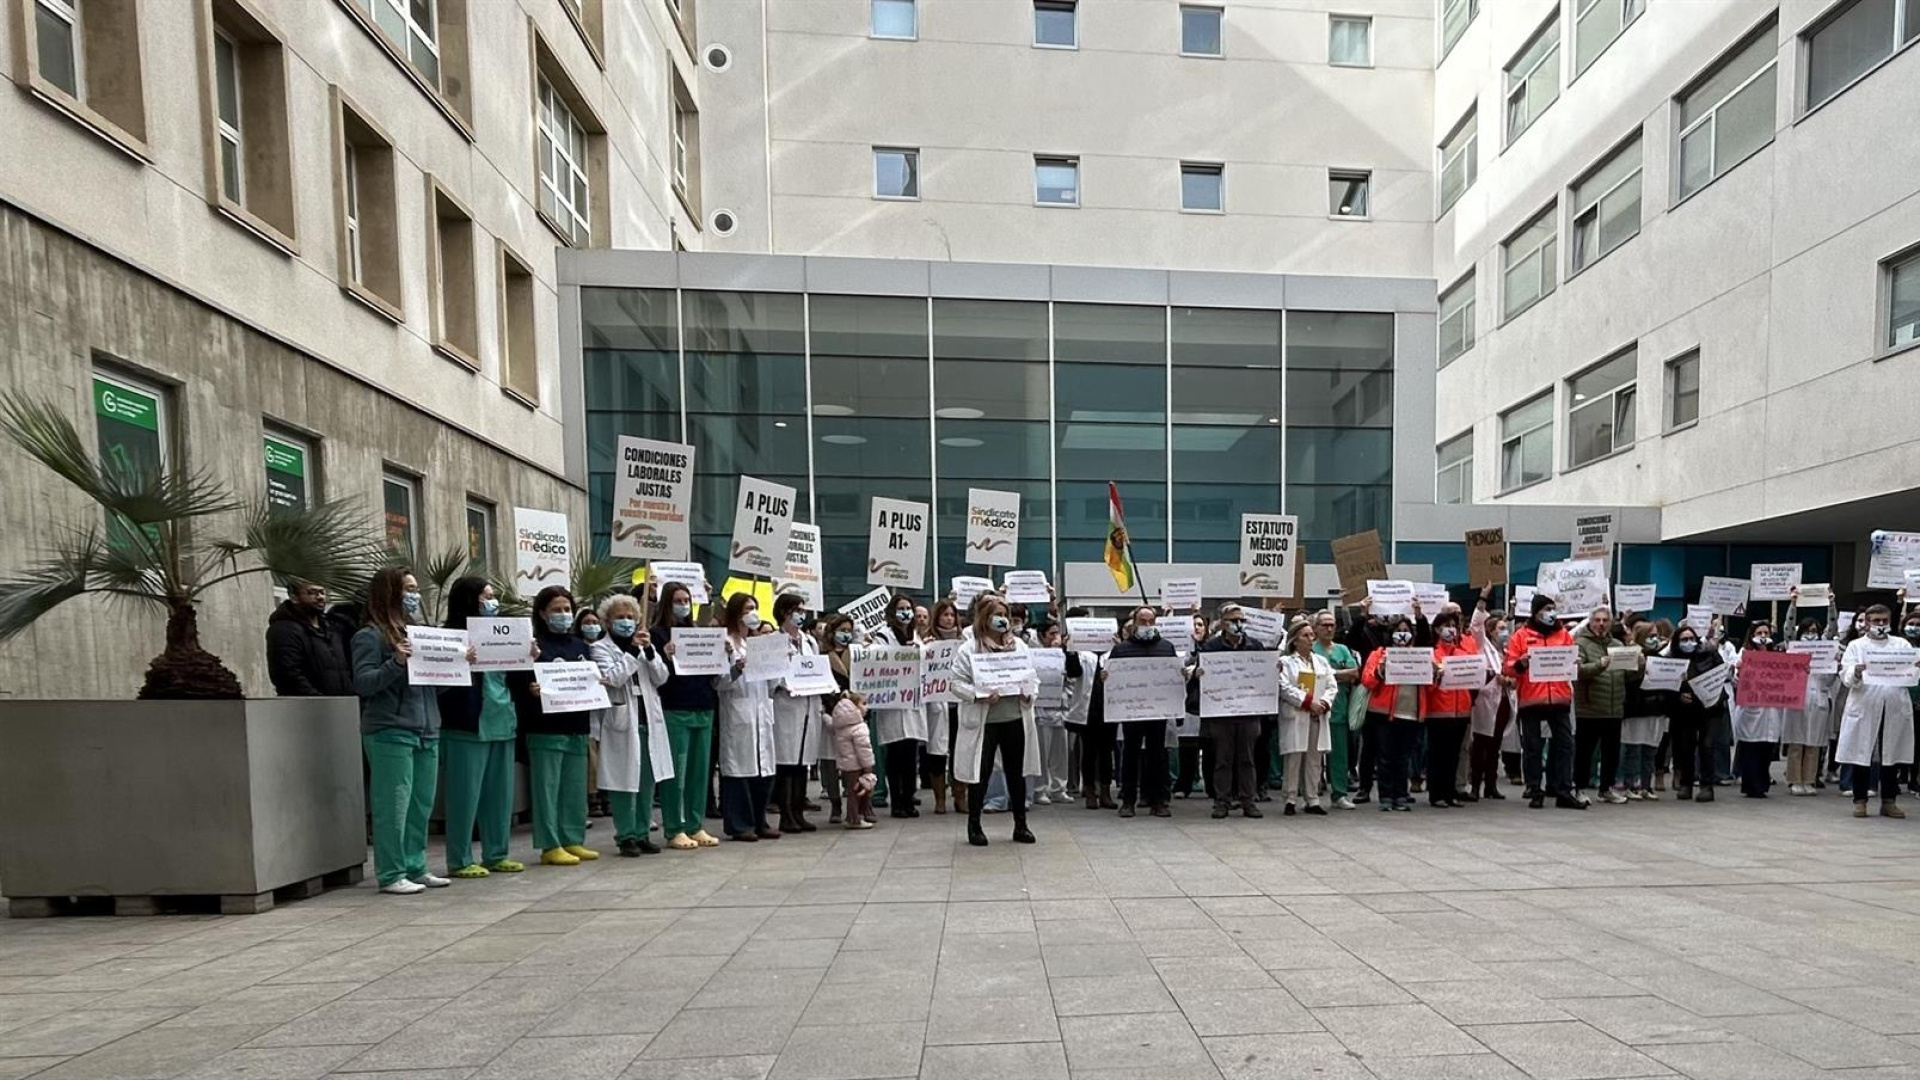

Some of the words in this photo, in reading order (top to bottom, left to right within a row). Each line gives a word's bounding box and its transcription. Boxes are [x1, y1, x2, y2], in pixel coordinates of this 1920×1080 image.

[624, 447, 687, 468] CONDICIONES
[628, 464, 682, 484] LABORALES
[636, 482, 672, 498] JUSTAS
[745, 490, 754, 510] A
[757, 494, 789, 517] PLUS
[971, 506, 1017, 519] Sindicato
[754, 515, 774, 535] A1+
[878, 510, 887, 528] A
[891, 512, 922, 532] PLUS
[1246, 521, 1294, 536] ESTATUTO
[519, 528, 566, 543] Sindicato
[888, 532, 909, 550] A1+
[1250, 534, 1288, 551] MÉDICO
[1252, 553, 1284, 567] JUSTO
[847, 593, 889, 620] STATUTO
[493, 625, 510, 635] NO
[801, 661, 814, 669] NO
[863, 668, 875, 677] LA
